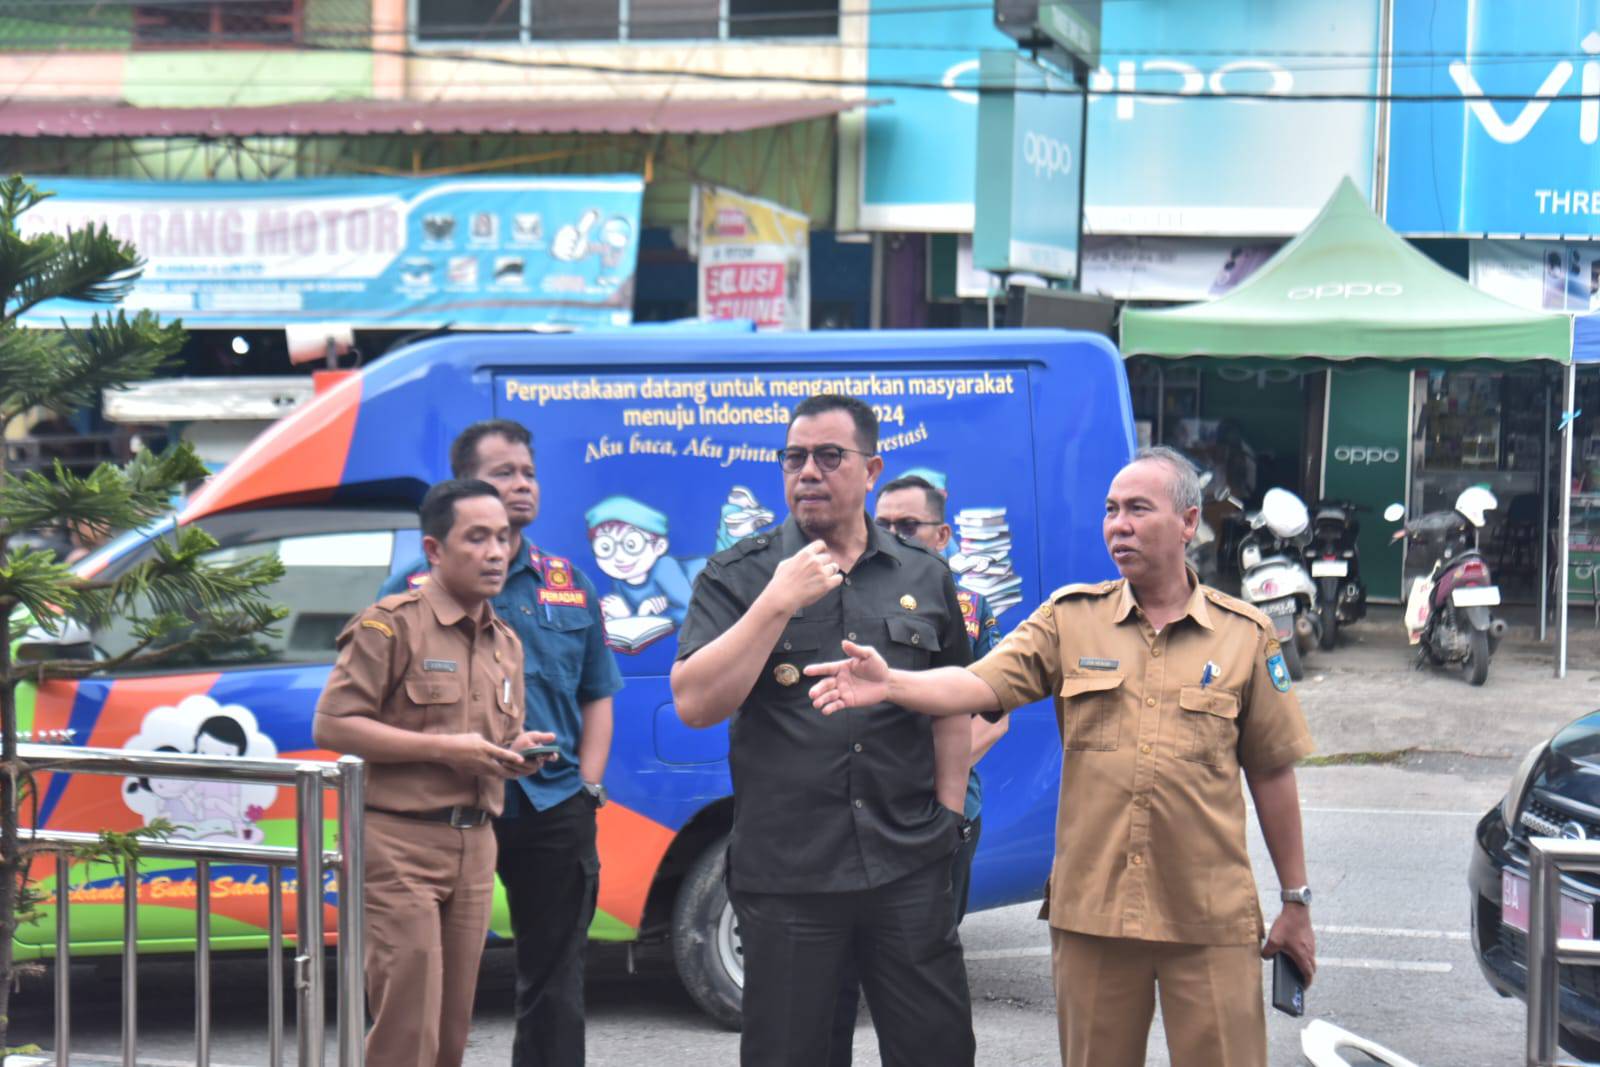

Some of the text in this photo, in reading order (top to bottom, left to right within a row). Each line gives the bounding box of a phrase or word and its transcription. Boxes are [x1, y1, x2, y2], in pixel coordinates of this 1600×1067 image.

[942, 59, 1293, 119] po
[1024, 131, 1072, 179] oppo
[257, 206, 400, 256] MOTOR
[1287, 282, 1403, 300] oppo
[506, 372, 1015, 406] Perpustakaan datang untuk mengantarkan masyarakat
[623, 401, 905, 431] menuju Indonesia 024
[584, 421, 928, 468] Aku baca, Aku pinta restasi
[1334, 446, 1400, 465] oppo
